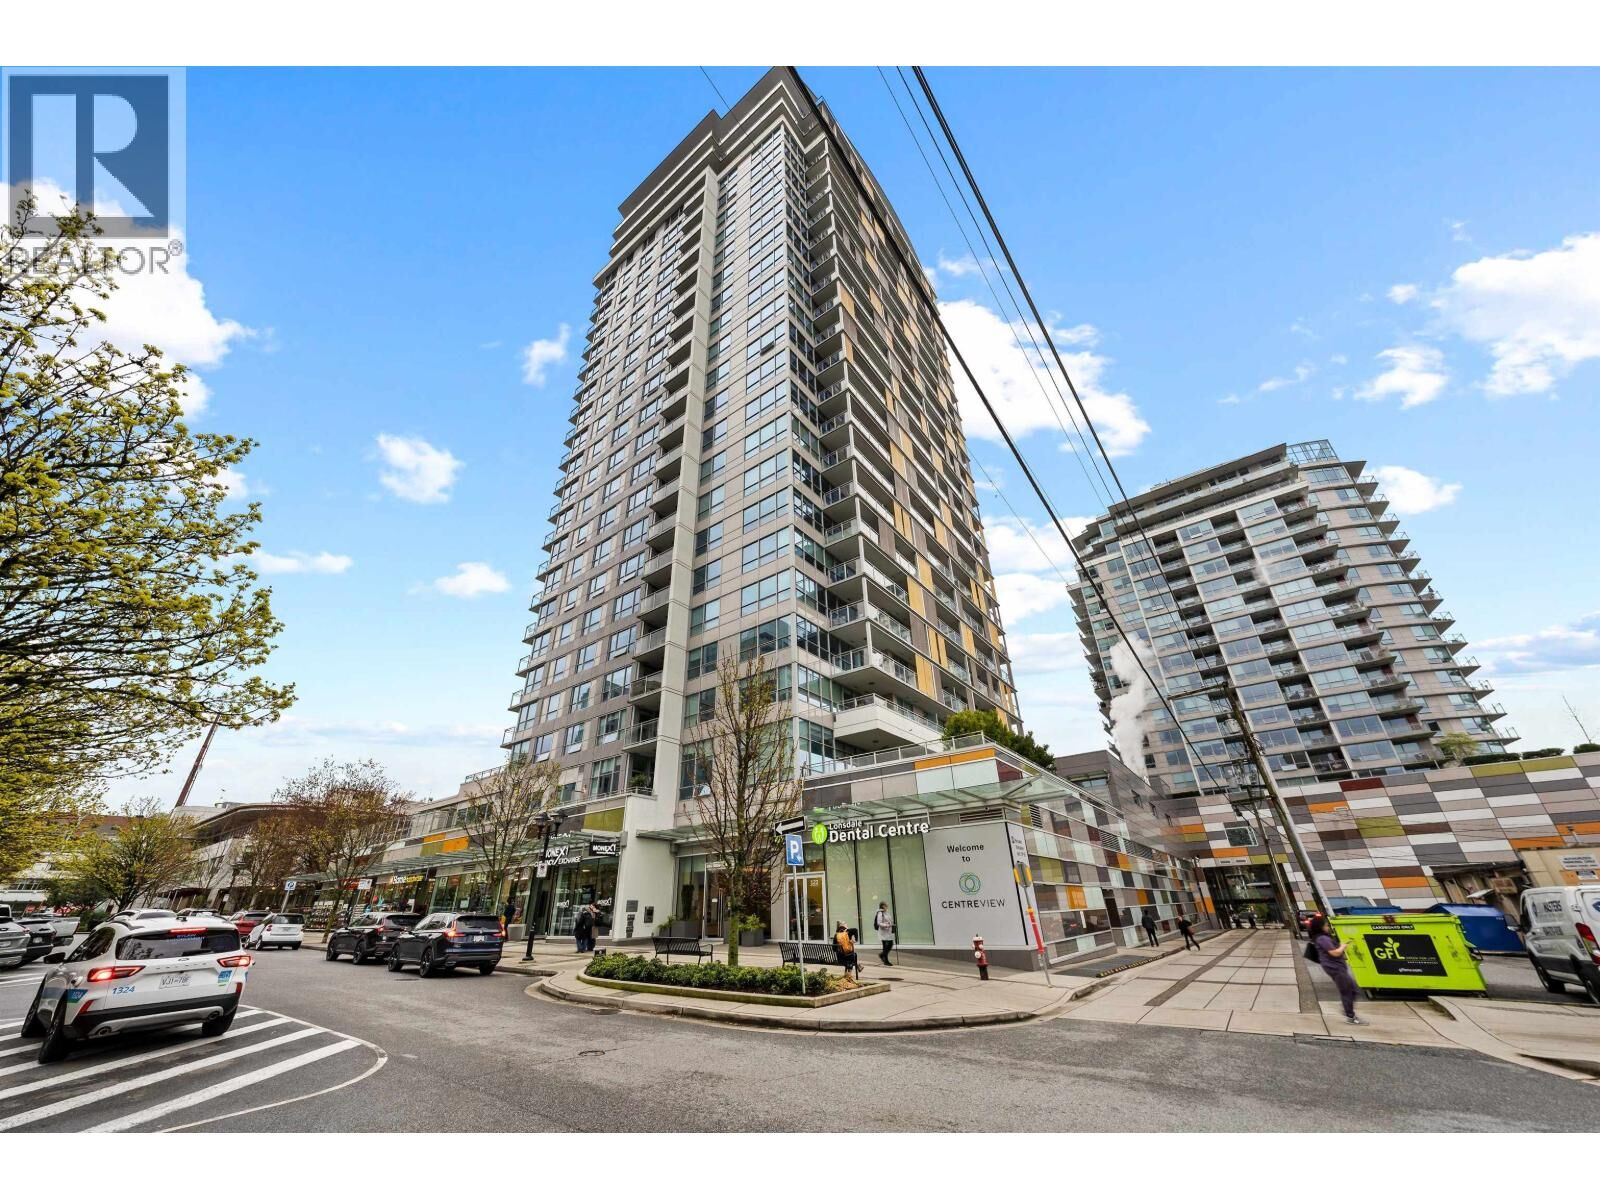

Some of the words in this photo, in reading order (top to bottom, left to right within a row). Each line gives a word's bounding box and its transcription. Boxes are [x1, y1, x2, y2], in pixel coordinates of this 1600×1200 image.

[829, 820, 862, 830] Lonsdale
[829, 829, 874, 843] Dental
[878, 821, 930, 838] Centre
[790, 840, 799, 859] P
[947, 845, 984, 853] Welcome
[941, 899, 1006, 909] CENTREVIEW
[1374, 942, 1405, 960] GFL
[112, 985, 135, 994] 1324
